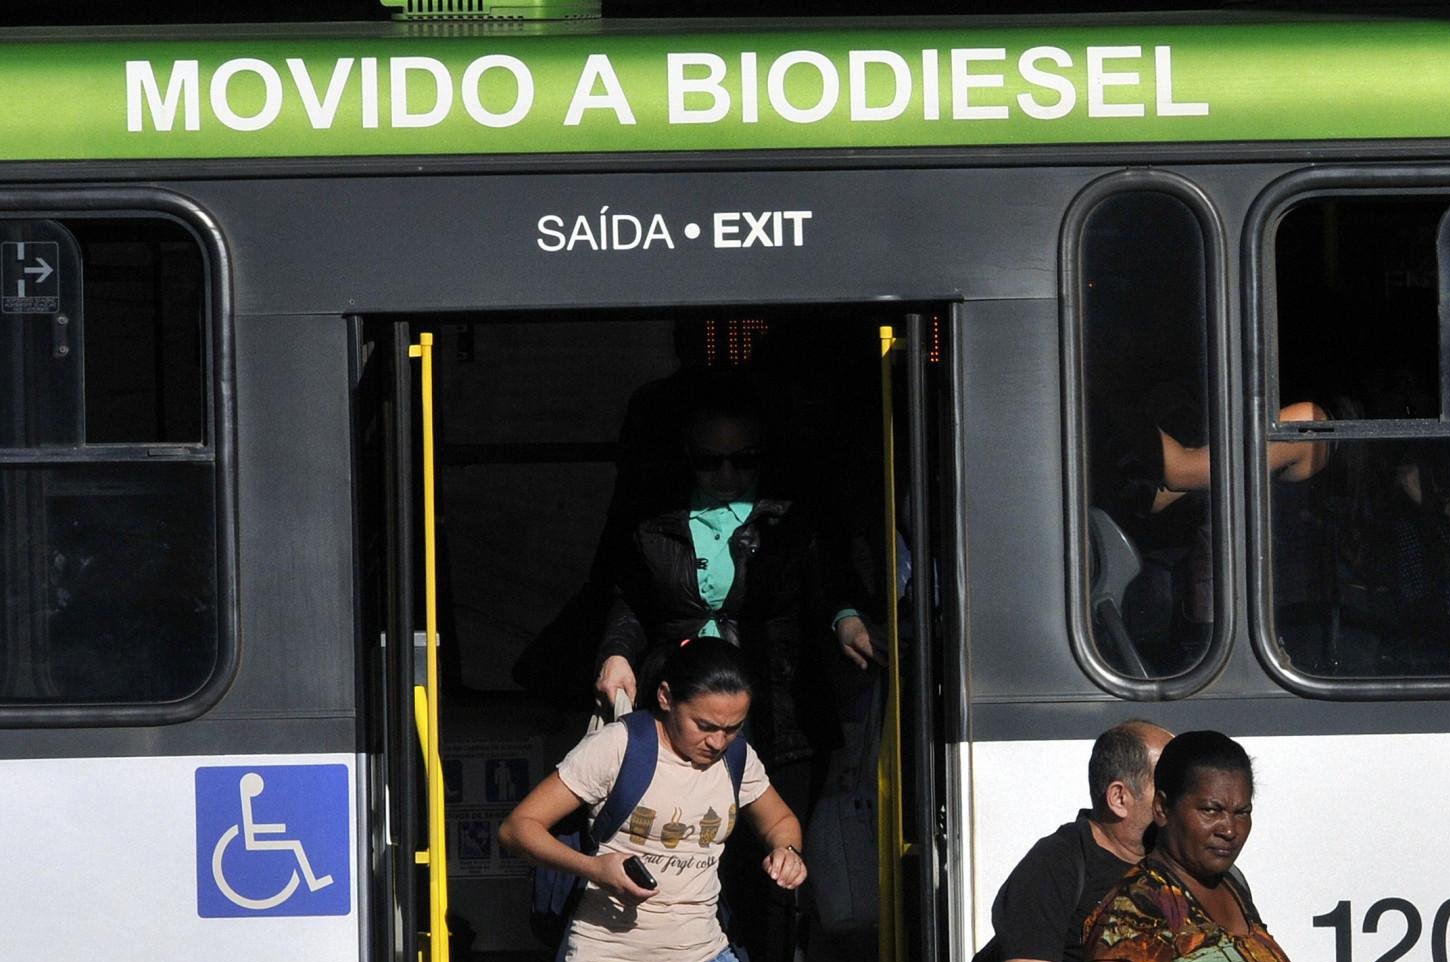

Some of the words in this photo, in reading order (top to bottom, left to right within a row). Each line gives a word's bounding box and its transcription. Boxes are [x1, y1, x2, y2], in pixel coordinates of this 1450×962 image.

[126, 55, 535, 132] MOVIDO
[563, 54, 637, 126] A
[666, 45, 1210, 124] BIODIESEL
[537, 205, 675, 252] SAÍDA
[713, 210, 813, 248] EXIT
